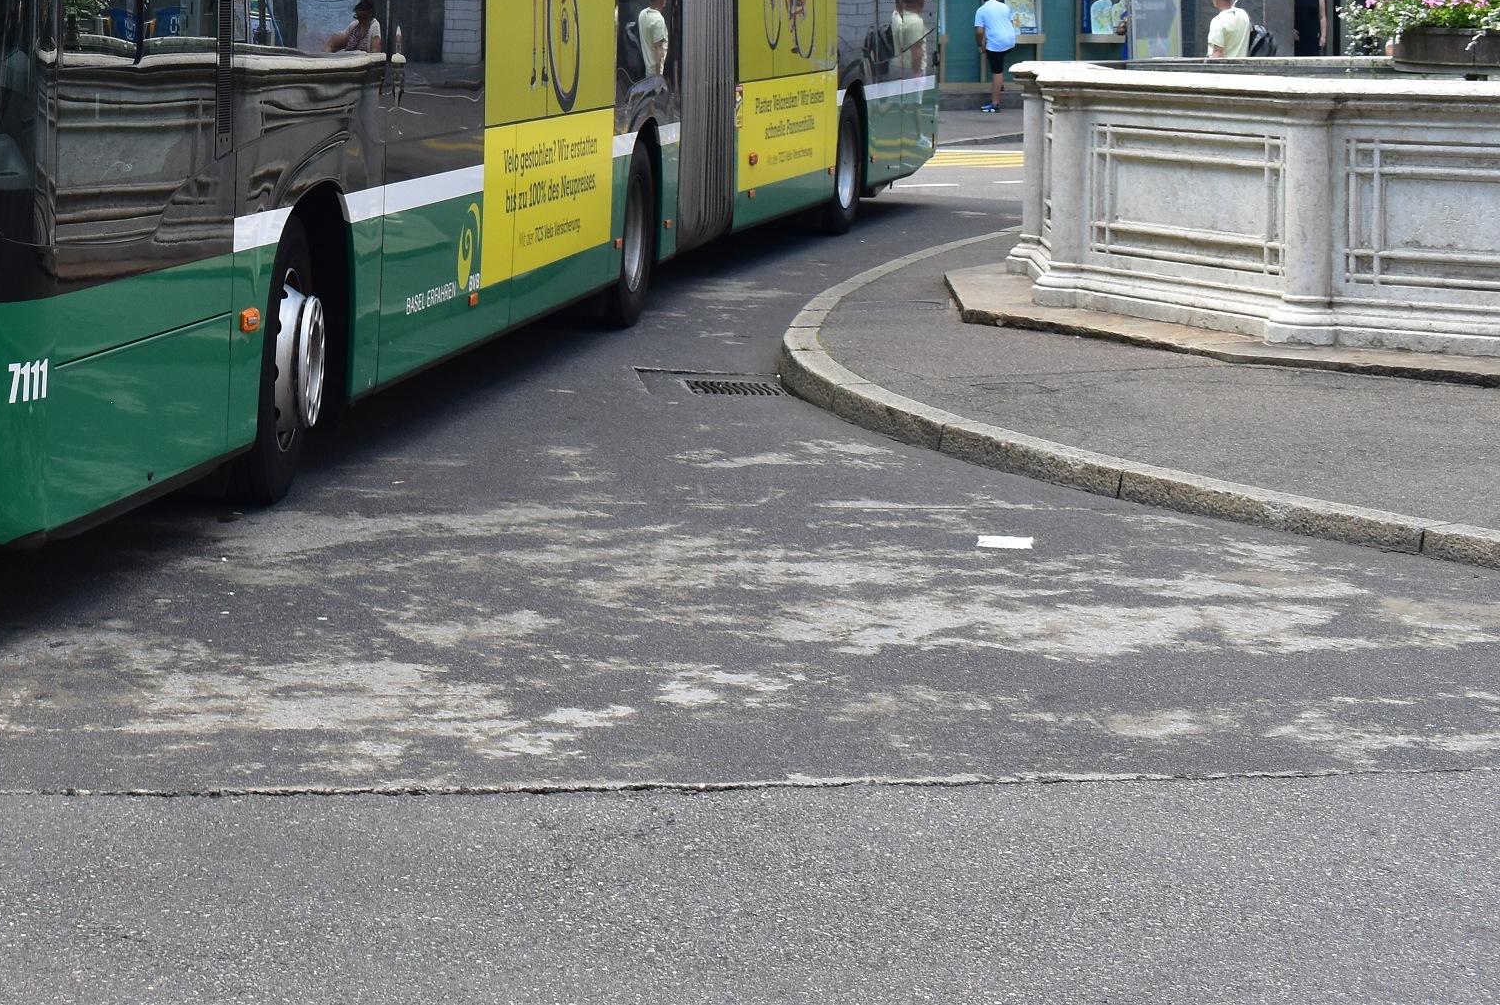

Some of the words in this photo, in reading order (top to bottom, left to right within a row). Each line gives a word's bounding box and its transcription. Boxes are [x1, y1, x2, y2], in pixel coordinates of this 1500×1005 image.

[504, 148, 519, 174] Velo
[520, 139, 556, 177] gestohlen?
[557, 138, 570, 162] Wir
[505, 188, 516, 213] bis
[518, 191, 528, 210] zu
[529, 180, 547, 208] 100%
[548, 178, 560, 202] des
[406, 292, 426, 315] BASEL
[426, 281, 457, 308] ERFAHREN
[468, 273, 480, 292] BVB
[8, 358, 48, 404] 7111
